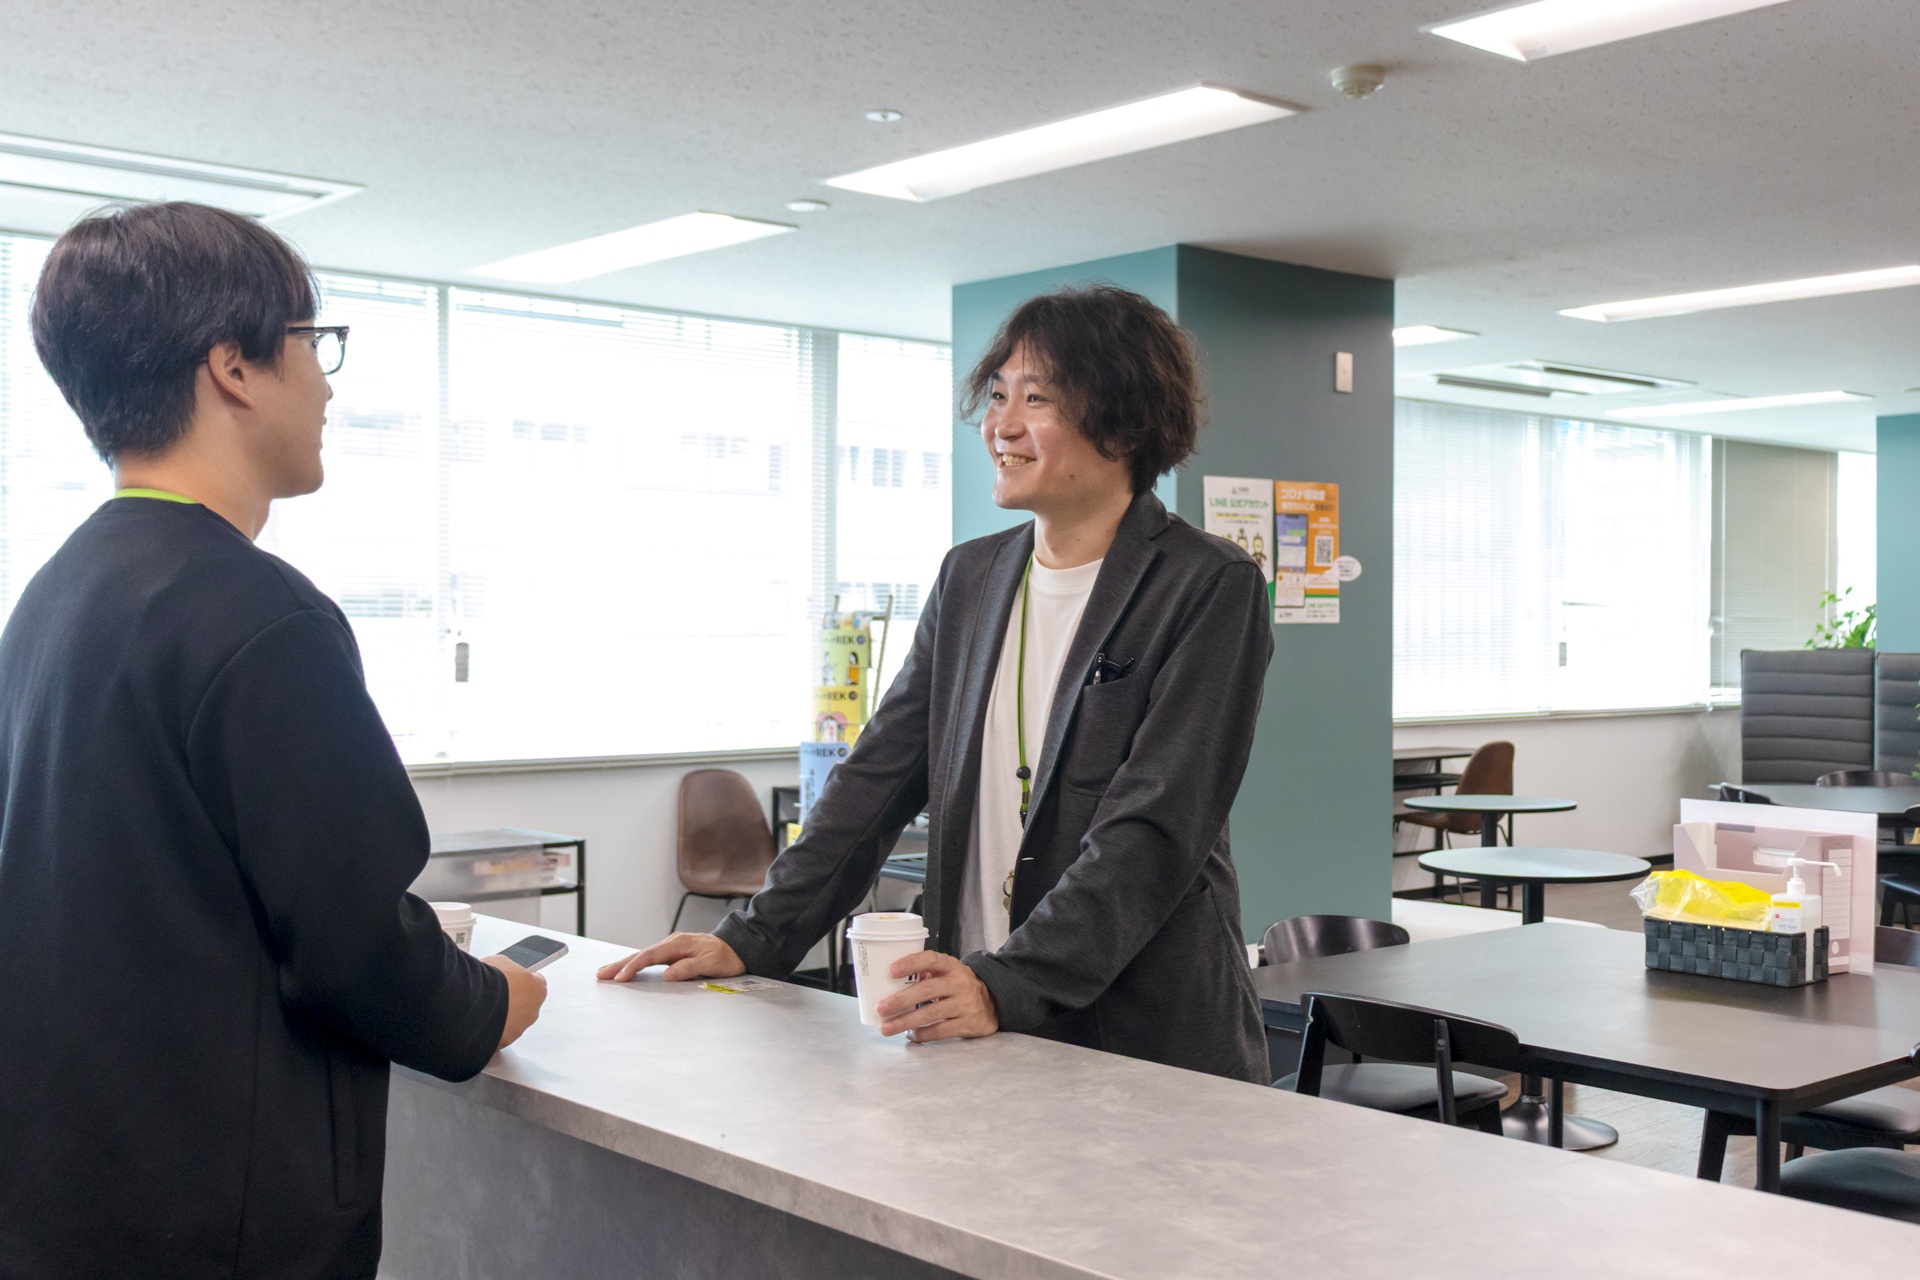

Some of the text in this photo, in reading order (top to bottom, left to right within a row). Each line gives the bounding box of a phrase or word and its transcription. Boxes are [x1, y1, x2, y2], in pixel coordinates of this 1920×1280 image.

[1209, 498, 1269, 509] LINE 公式アカウント
